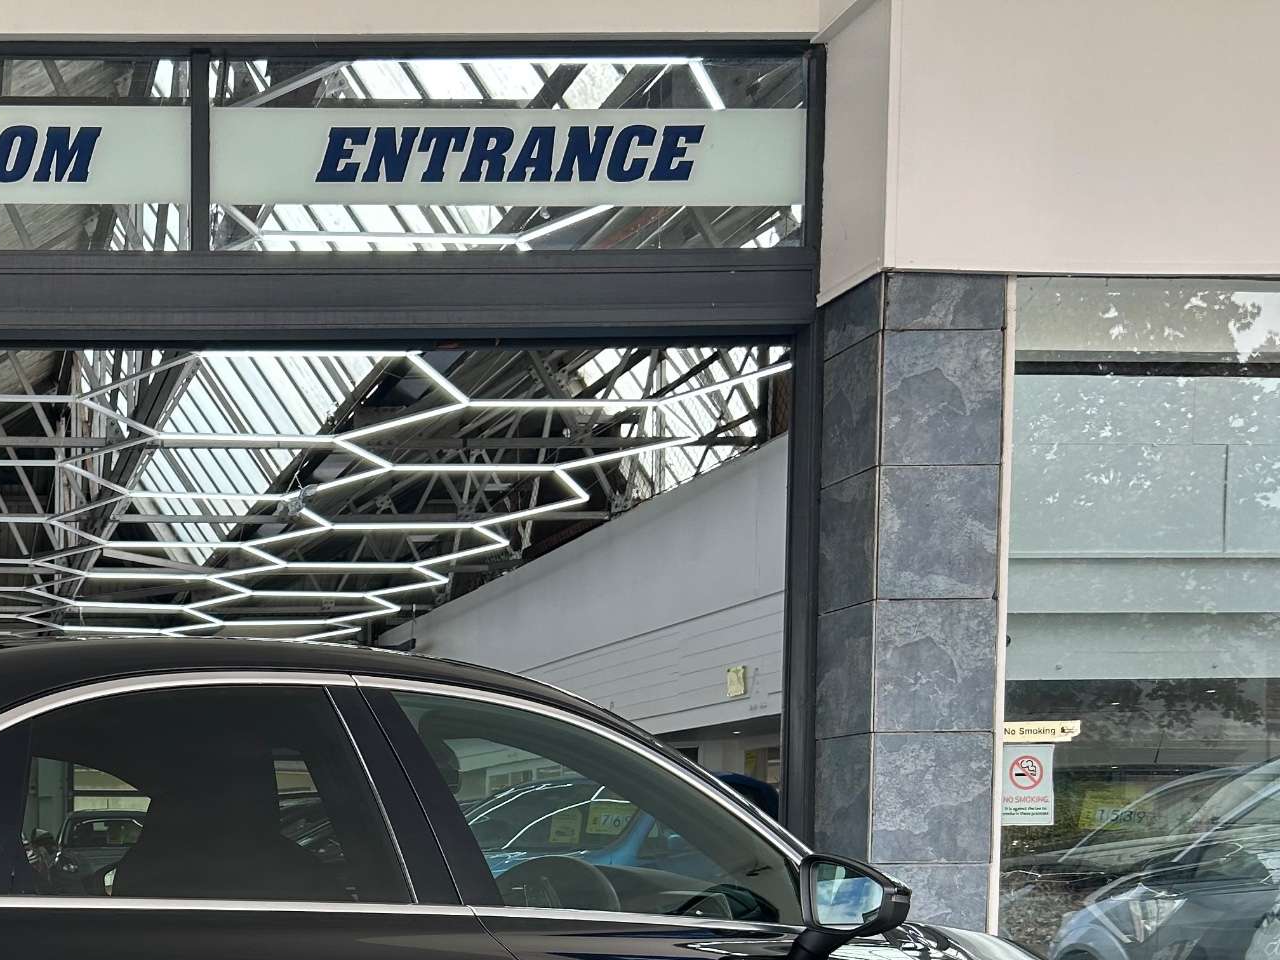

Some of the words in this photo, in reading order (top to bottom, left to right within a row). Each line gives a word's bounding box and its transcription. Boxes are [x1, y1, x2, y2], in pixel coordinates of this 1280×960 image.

[315, 124, 706, 183] ENTRANCE
[1004, 727, 1016, 735] No
[1019, 727, 1056, 736] Smoking
